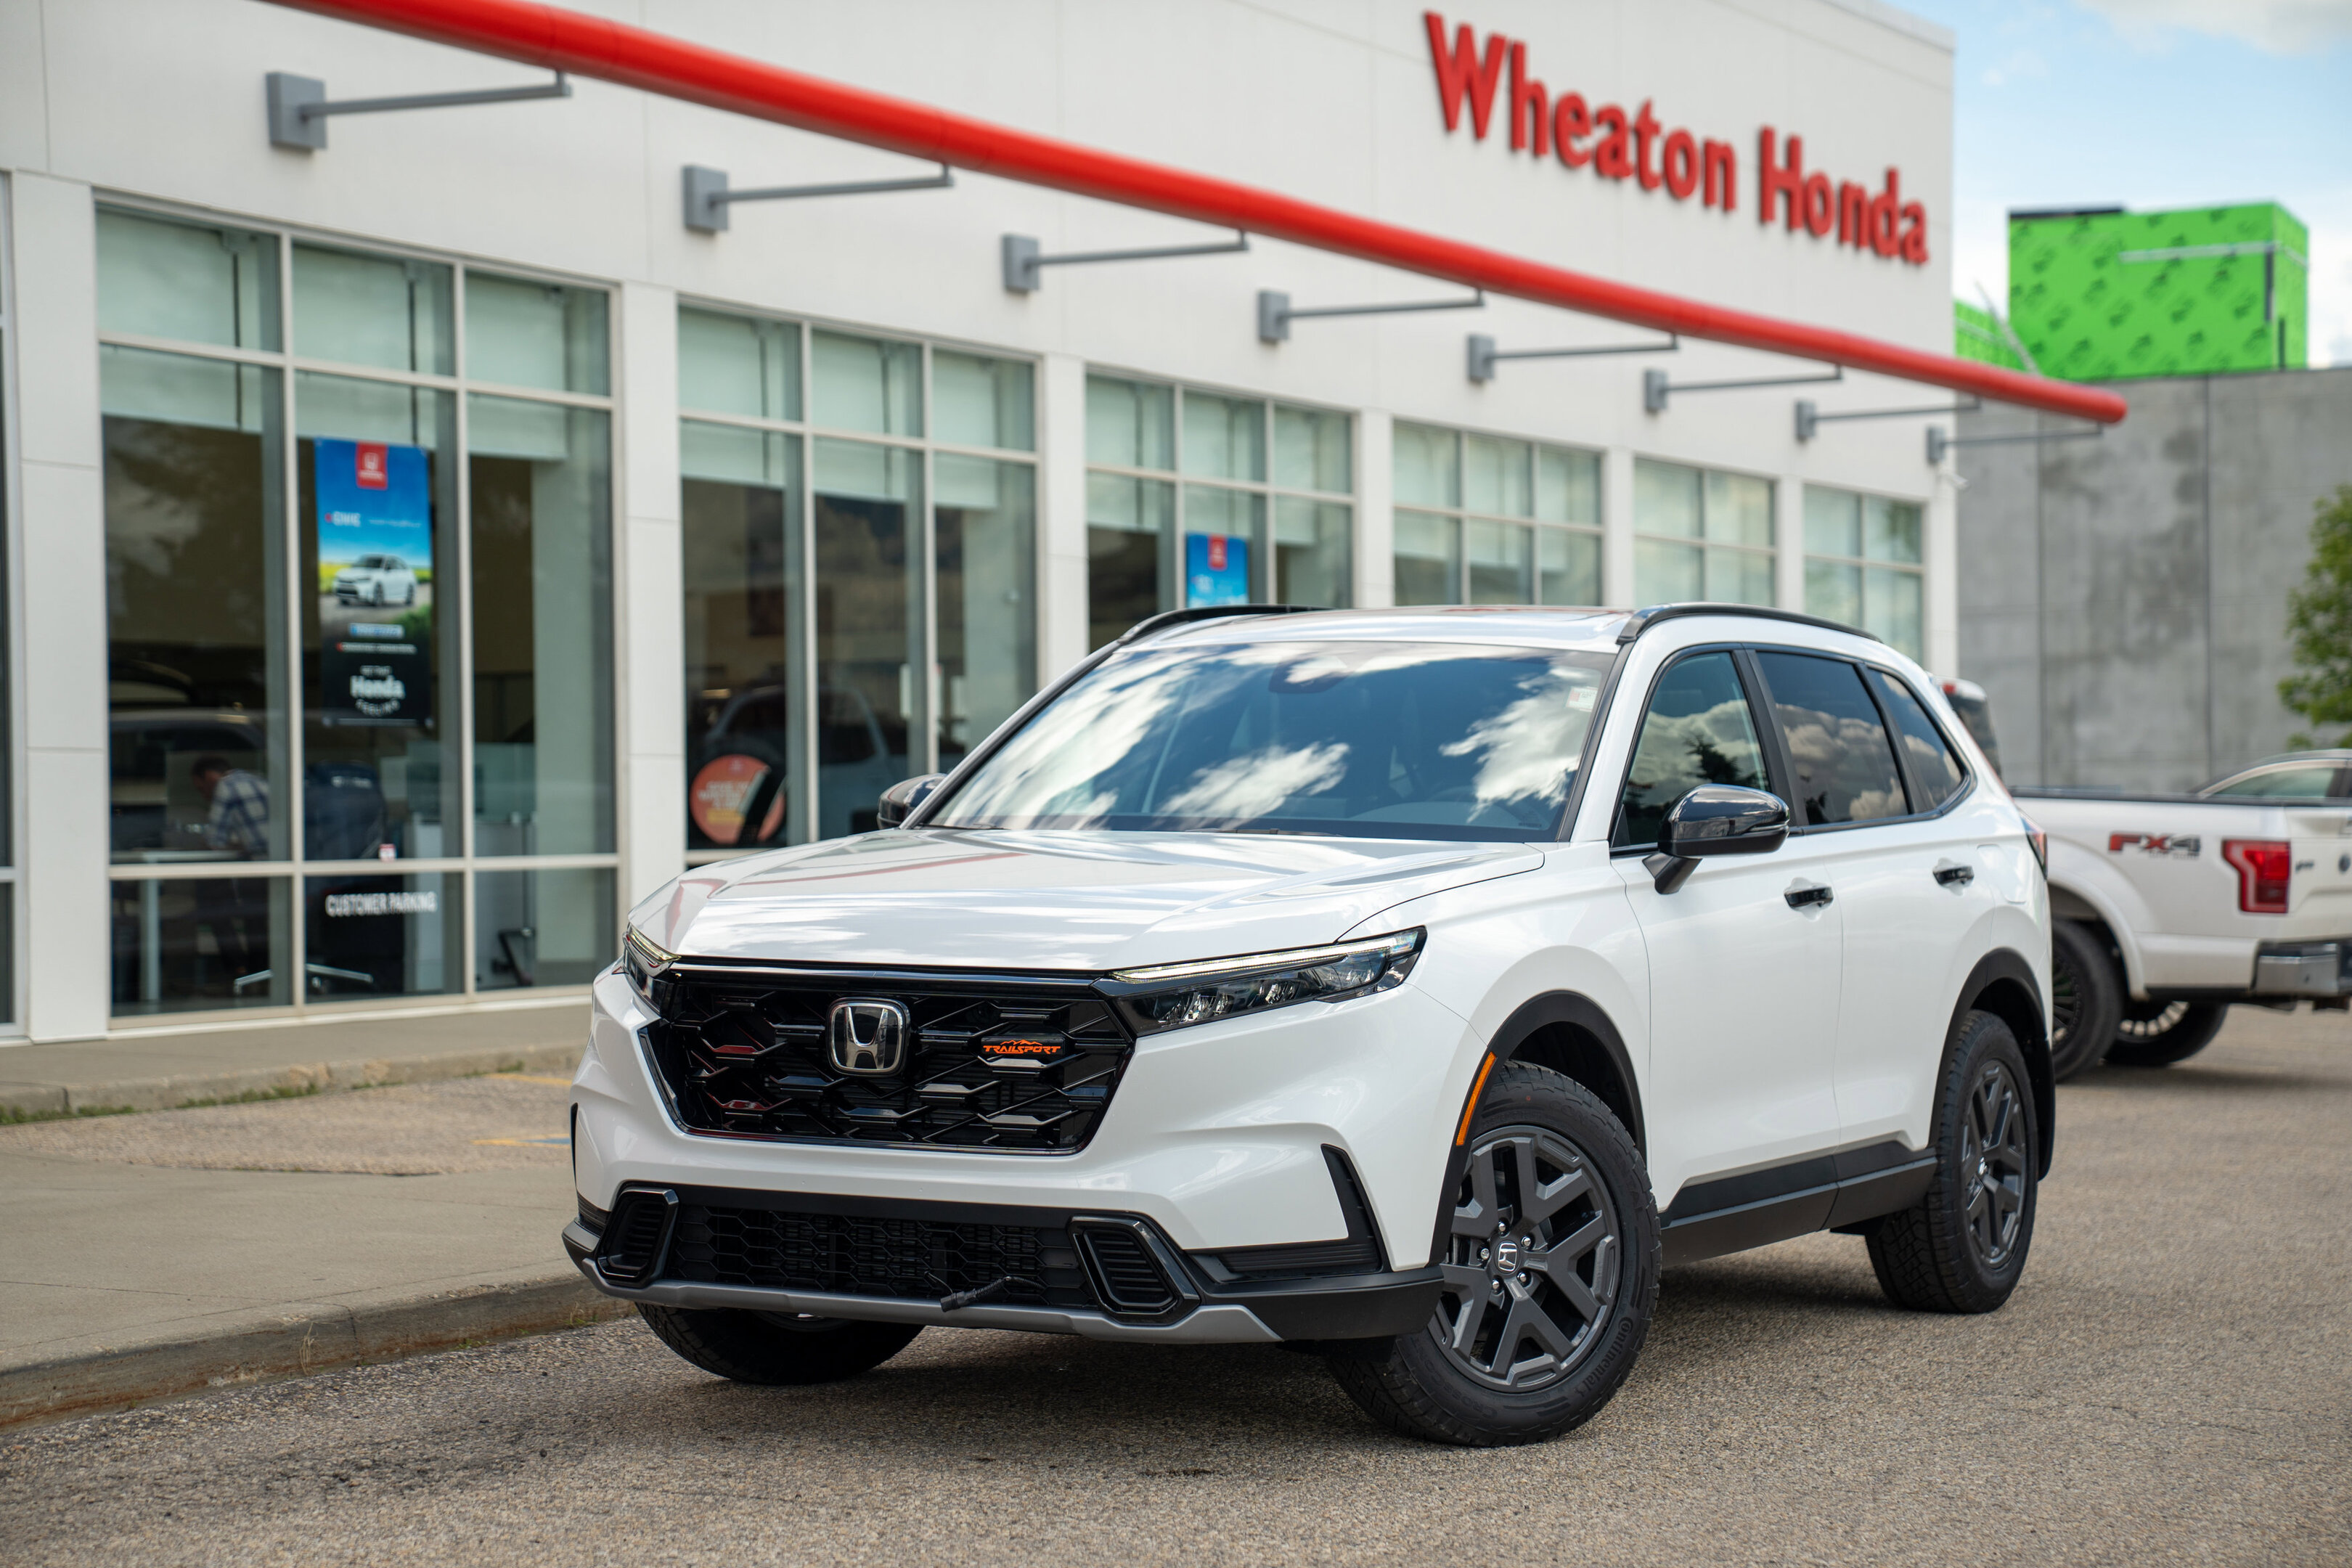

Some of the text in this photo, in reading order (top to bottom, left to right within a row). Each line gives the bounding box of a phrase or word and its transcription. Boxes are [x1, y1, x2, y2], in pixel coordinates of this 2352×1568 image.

[1425, 11, 1928, 264] Wheaton Honda
[350, 675, 405, 699] Honda
[2109, 832, 2200, 852] FX4
[326, 892, 436, 917] CUSTOMER PARKING
[983, 1045, 1061, 1054] TRAILSPORT
[1583, 1317, 1633, 1390] Continental
